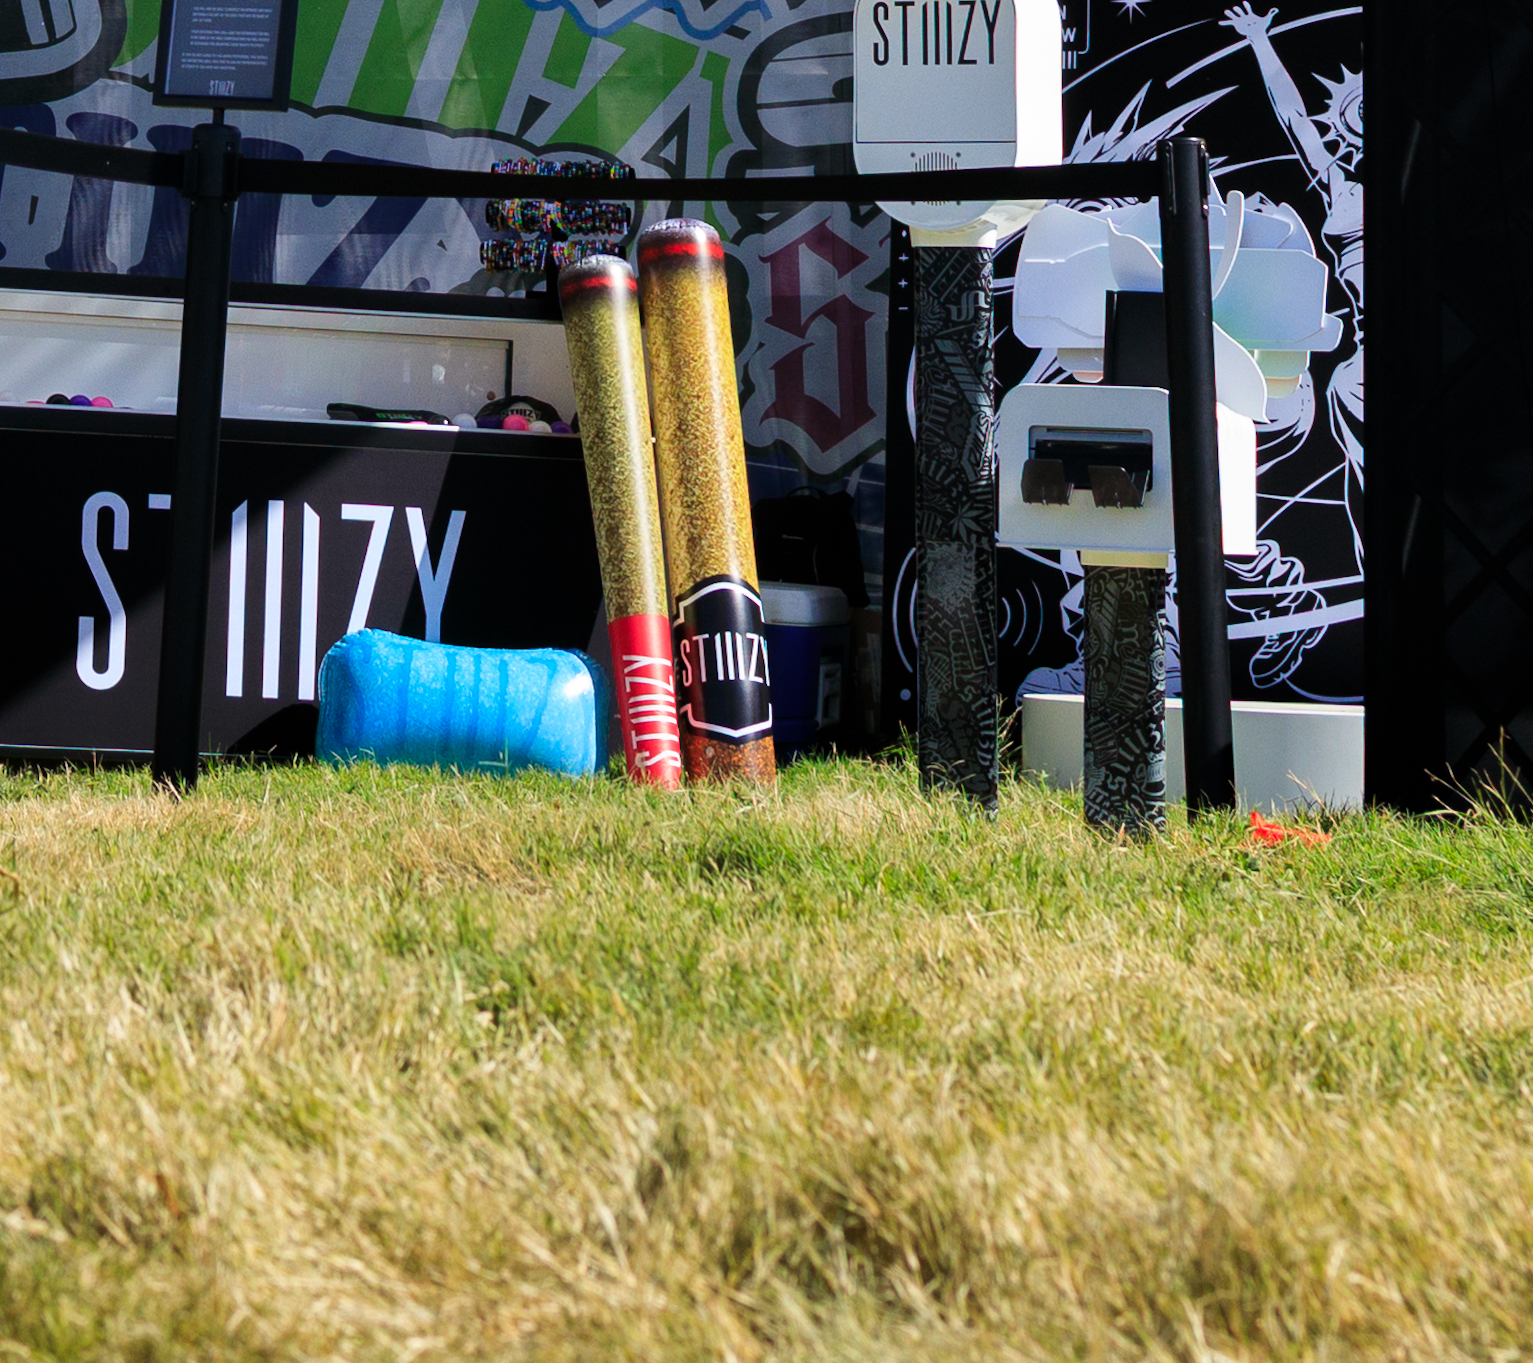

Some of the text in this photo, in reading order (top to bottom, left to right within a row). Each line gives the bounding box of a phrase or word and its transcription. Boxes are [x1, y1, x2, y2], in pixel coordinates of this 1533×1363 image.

[872, 0, 1002, 66] STIIIZY
[75, 490, 467, 701] SIIIZY
[679, 630, 771, 688] STIIIZY
[622, 654, 682, 769] STIIIZY
